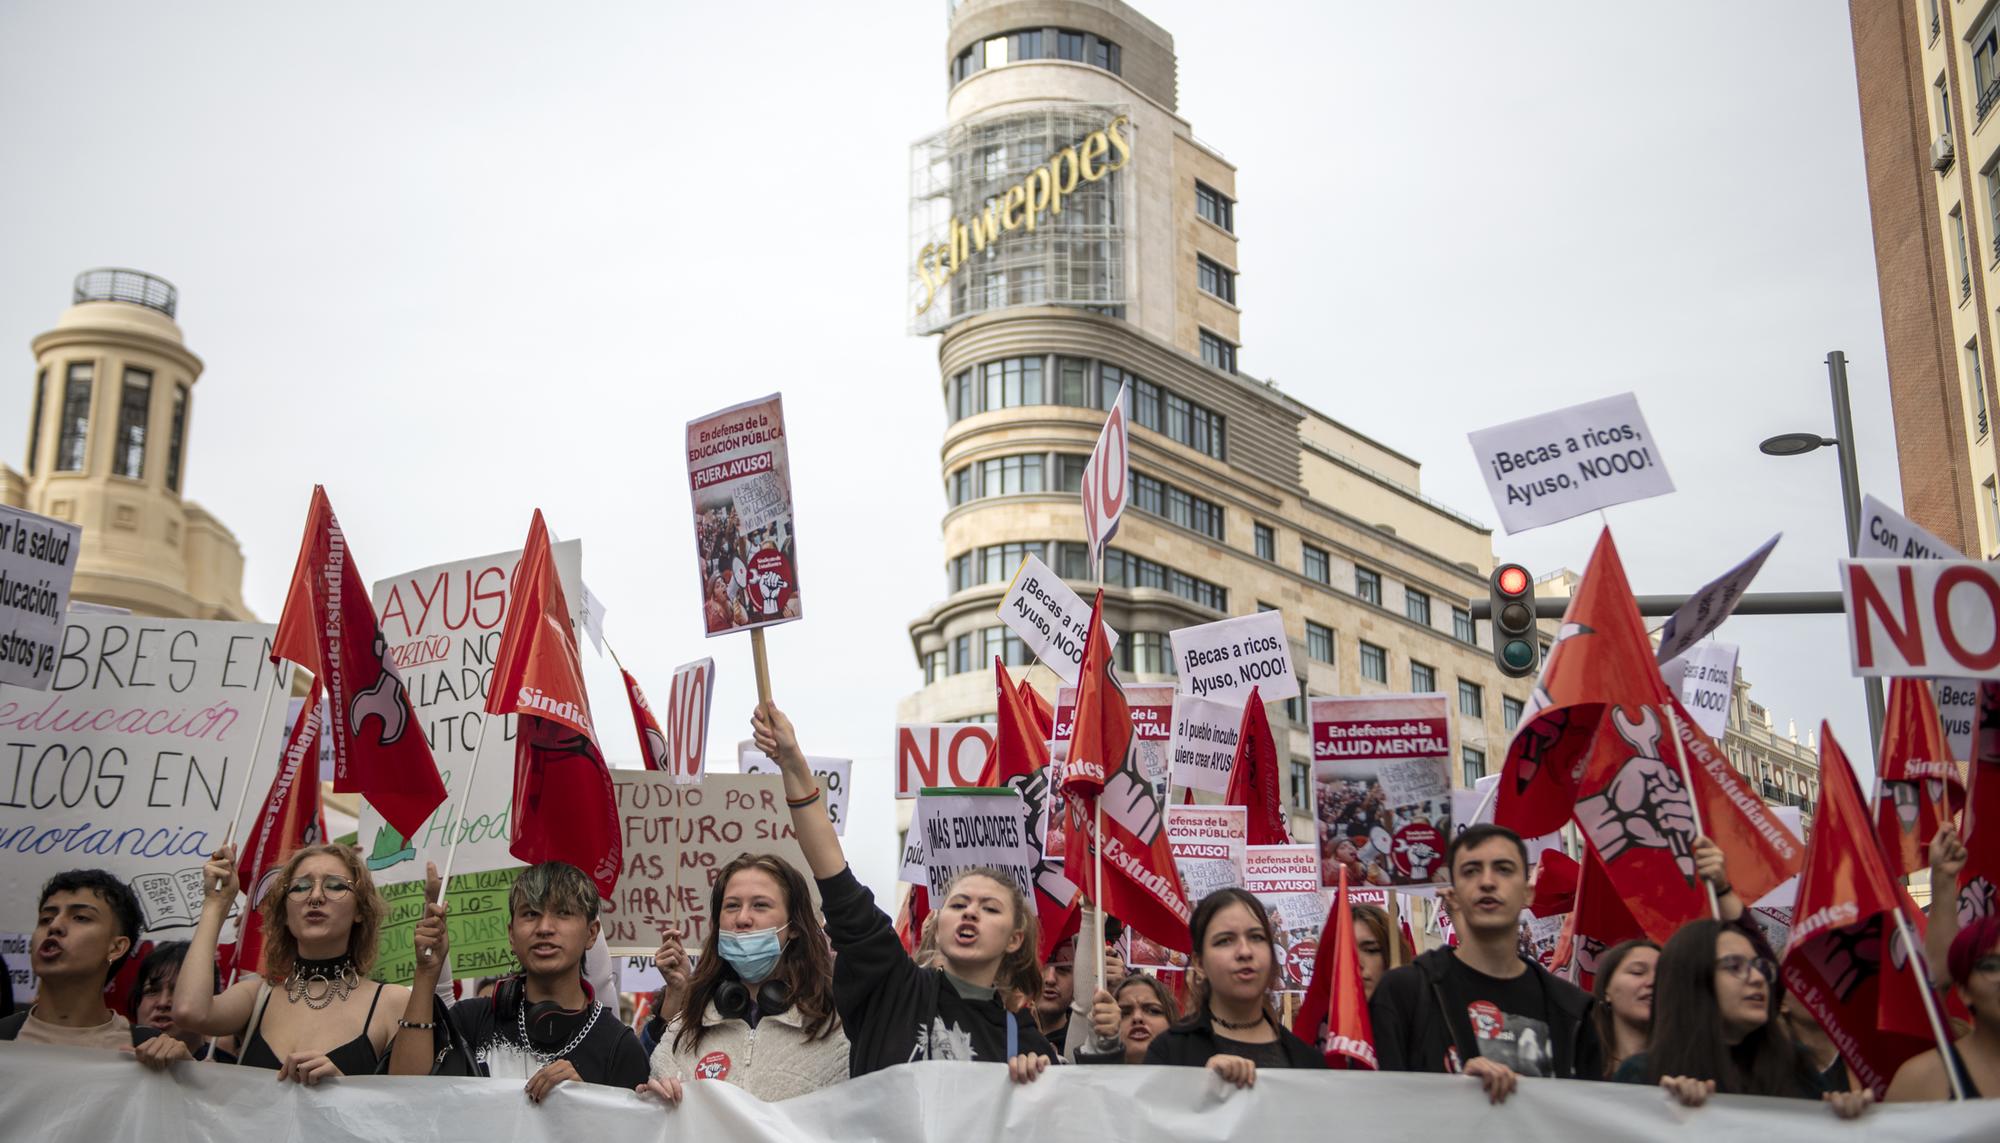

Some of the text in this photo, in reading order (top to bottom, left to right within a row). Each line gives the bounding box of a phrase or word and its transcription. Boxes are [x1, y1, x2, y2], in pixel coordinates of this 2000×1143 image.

[915, 113, 1131, 315] Schweppes
[689, 427, 783, 461] EDUCACIÓN PÚBLICA
[700, 413, 768, 443] En defensa de la
[1491, 423, 1642, 481] ¡Becas a ricos,
[694, 454, 771, 490] ¡FUERA AYUSO!
[1082, 405, 1124, 545] NO
[1506, 447, 1654, 506] Ayuso, NOOO!
[12, 518, 26, 554] la
[29, 527, 71, 566] salud
[1870, 516, 1898, 552] Con
[380, 558, 523, 637] AYUS
[1021, 577, 1062, 619] ¡Becas
[1062, 615, 1071, 628] a
[1013, 596, 1051, 641] Ayuso,
[1848, 564, 2000, 672] NO
[221, 636, 290, 691] EN
[1184, 636, 1282, 673] ¡Becas a ricos,
[1191, 656, 1287, 697] Ayuso, NOOO!
[668, 665, 704, 777] NO
[1131, 709, 1157, 720] de la
[1328, 722, 1432, 738] En defensa de la
[1189, 721, 1212, 742] pueblo
[1212, 724, 1238, 747] inculto
[1315, 737, 1448, 756] SALUD MENTAL
[899, 726, 997, 793] NO
[1196, 751, 1211, 769] crear
[147, 751, 228, 811] EN
[725, 788, 778, 815] POR
[1707, 758, 1796, 860] Estudiantes
[625, 815, 742, 848] FUTURO
[927, 811, 1019, 858] ¡MÁS EDUCADORES
[1199, 825, 1246, 840] PÚBLICA
[1204, 816, 1217, 827] de
[1218, 816, 1228, 827] la
[680, 851, 716, 868] NO
[1184, 845, 1228, 859] AYUSO!
[1255, 855, 1291, 865] defensa
[1292, 855, 1304, 864] de
[1305, 855, 1314, 864] la
[461, 895, 493, 912] LOS
[1275, 880, 1316, 892] AYUSO!
[457, 946, 509, 968] ESPAÑA
